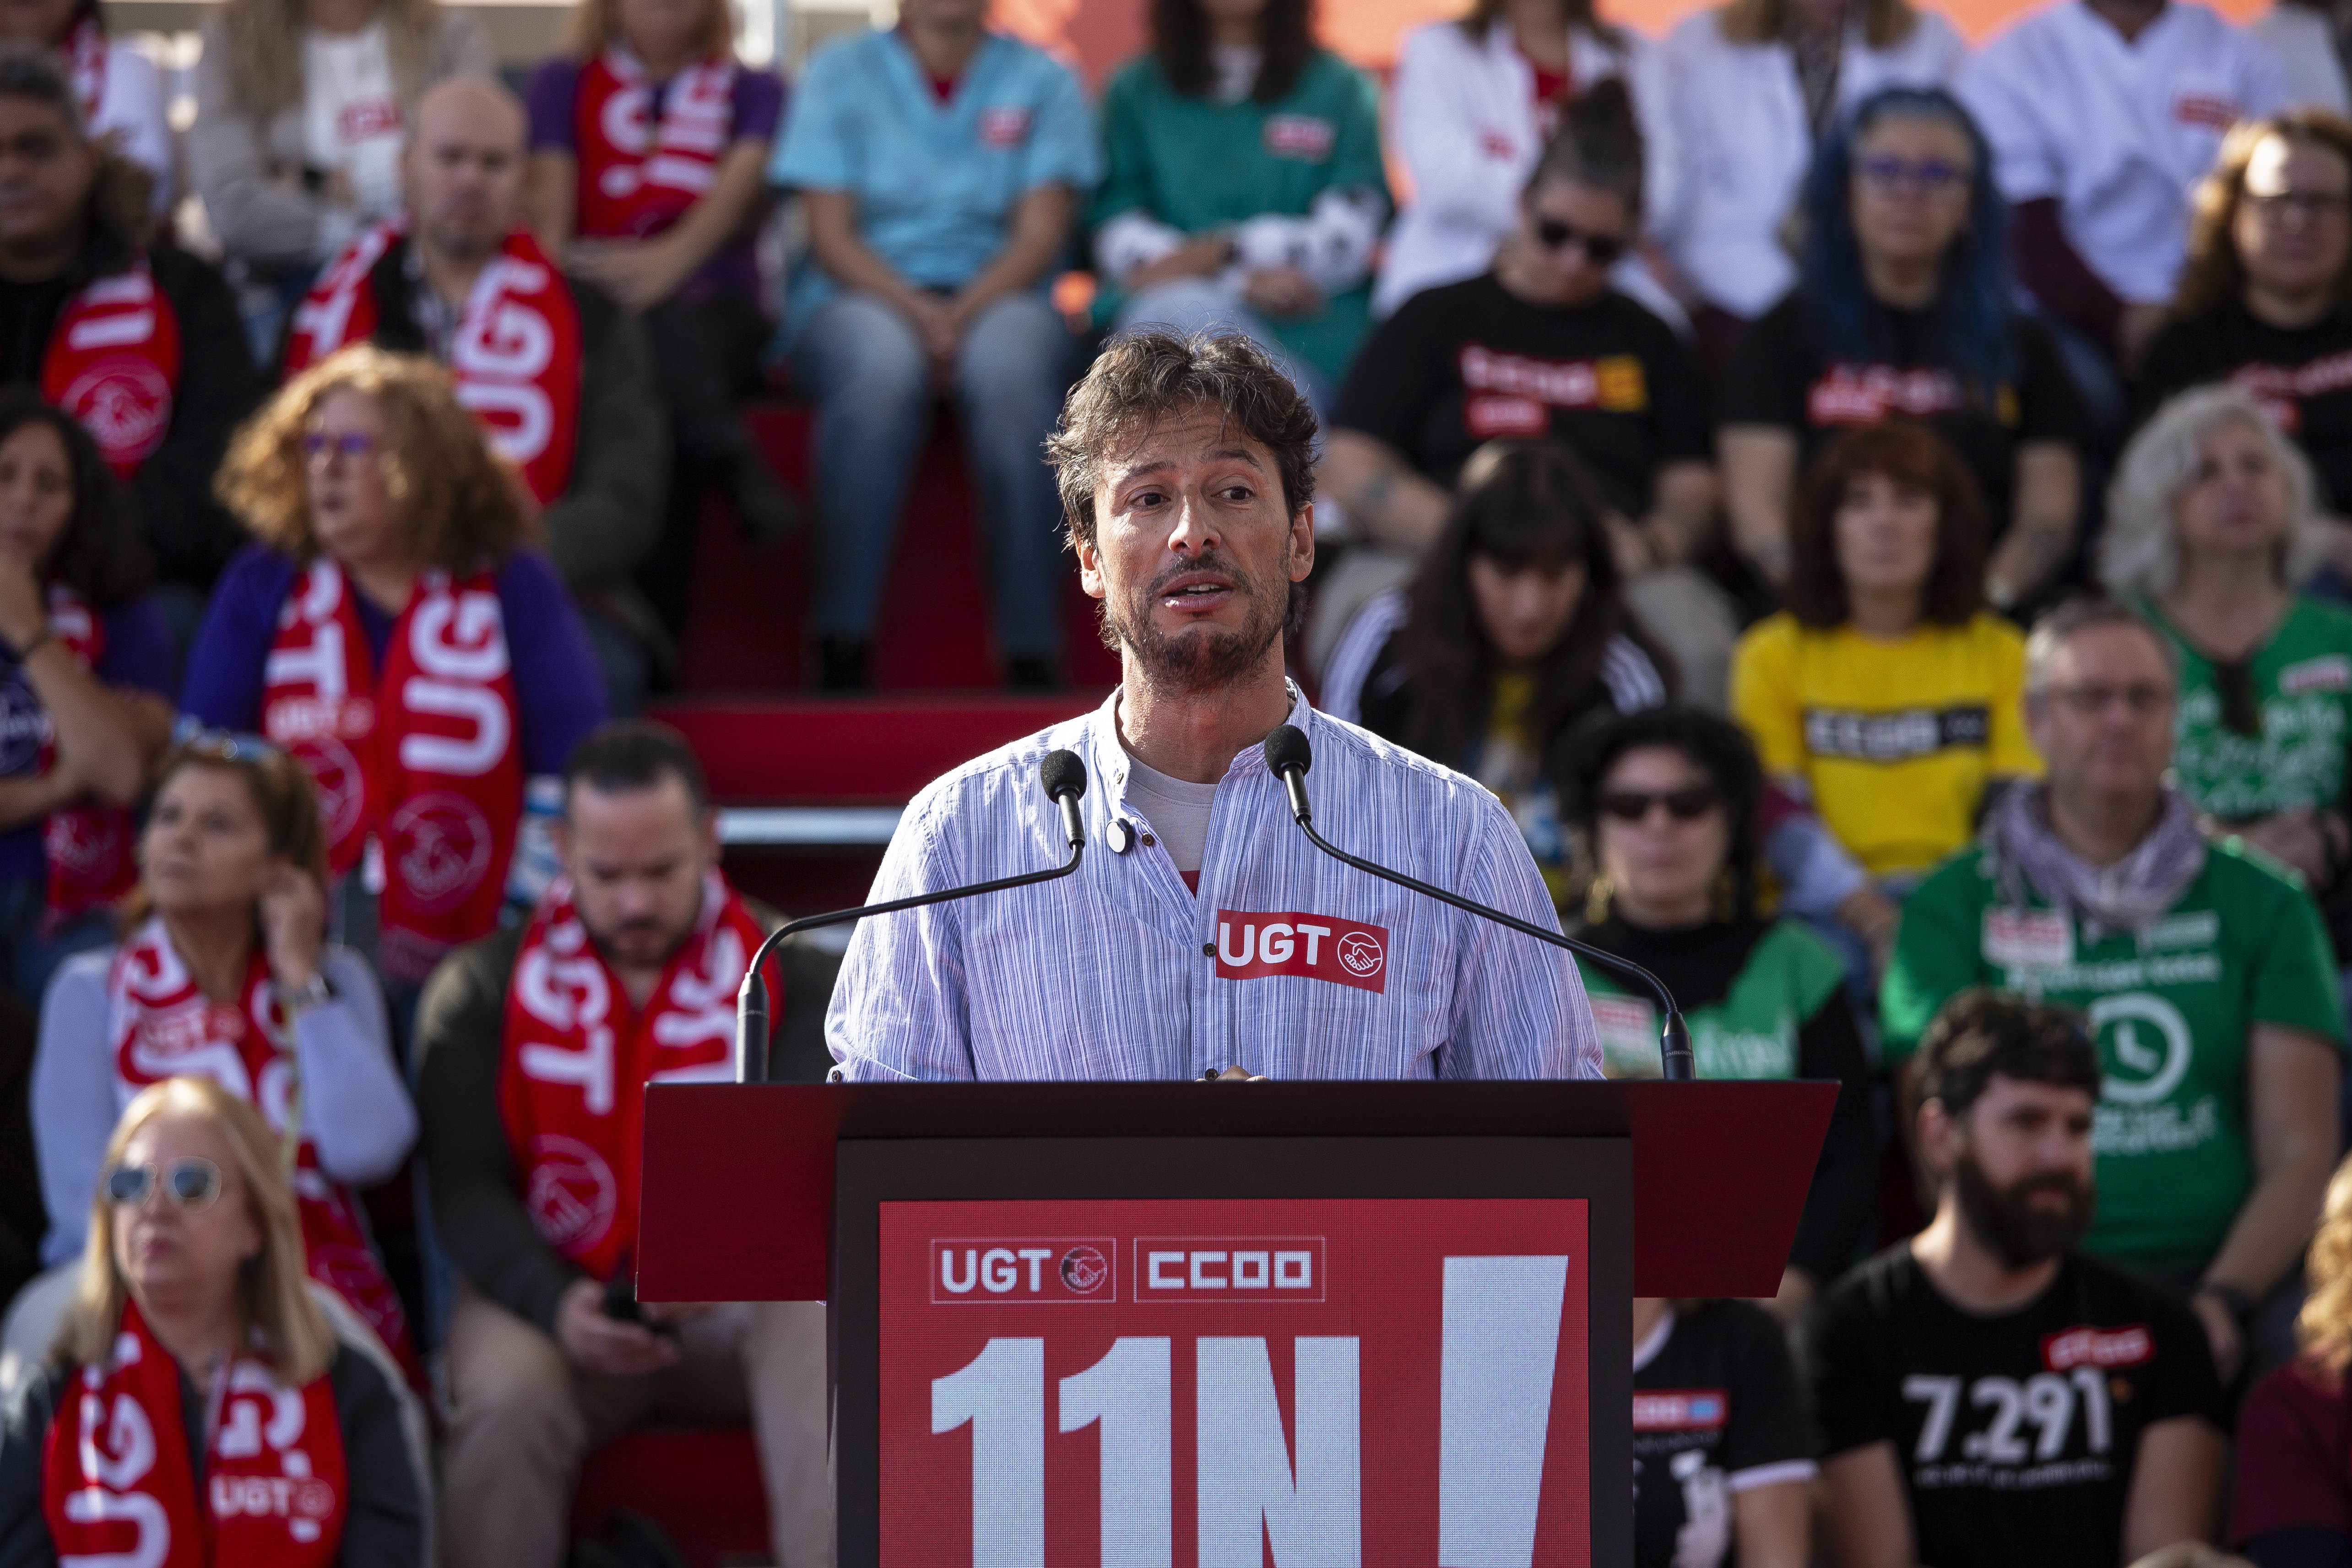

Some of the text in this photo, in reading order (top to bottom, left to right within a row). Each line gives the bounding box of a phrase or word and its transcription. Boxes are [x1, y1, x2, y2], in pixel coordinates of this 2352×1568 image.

[1219, 922, 1331, 967] UGT
[941, 1248, 1052, 1293] UGT
[1148, 1250, 1312, 1289] CCOO
[1902, 1365, 2111, 1464] 7.291
[211, 1472, 294, 1519] UGT
